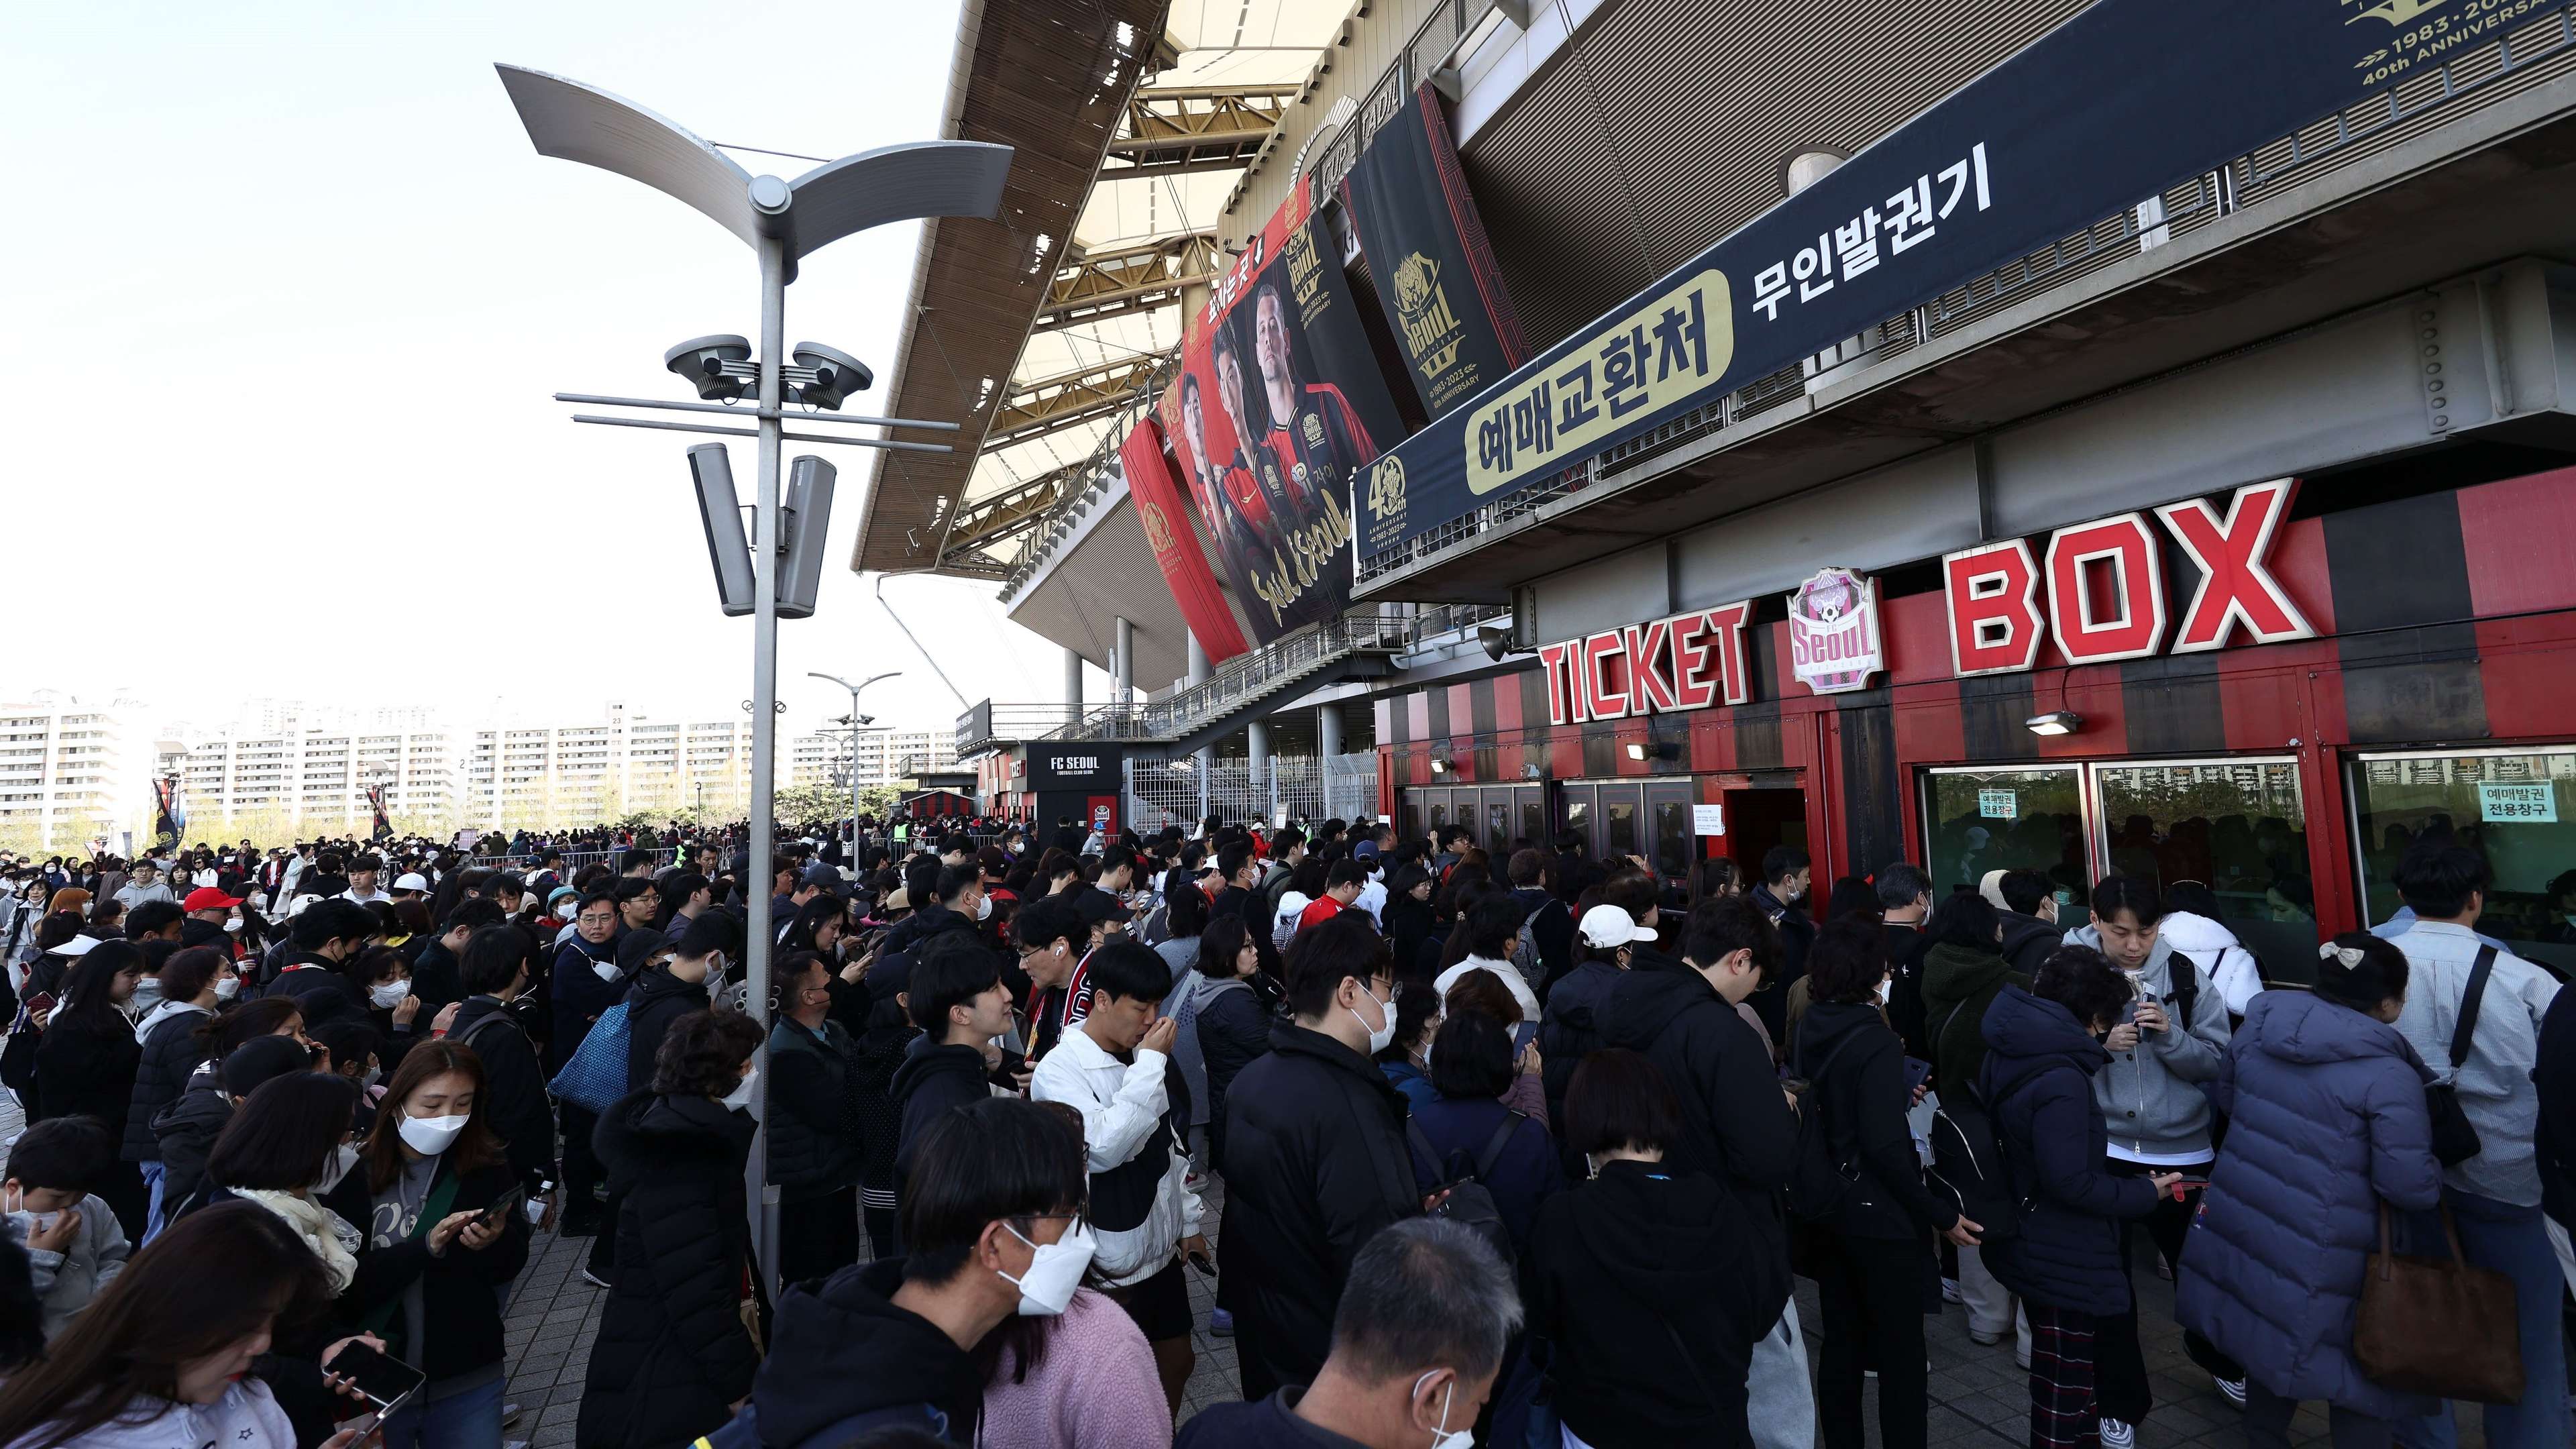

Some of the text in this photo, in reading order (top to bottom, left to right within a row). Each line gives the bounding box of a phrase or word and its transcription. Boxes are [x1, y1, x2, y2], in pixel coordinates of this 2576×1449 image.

[2362, 57, 2410, 86] 40th
[1398, 281, 1461, 360] Seoul
[1417, 308, 1424, 319] FC
[1479, 142, 1992, 474] 예매교환처 무인발권기
[1440, 373, 1480, 404] ANNIVERSARY
[1369, 512, 1407, 535] ANNIVERSARY
[1536, 477, 2317, 727] TICKET BOX
[1792, 607, 1875, 666] Seoul
[1051, 756, 1100, 770] FC SEOUL
[2487, 788, 2544, 801] 예매발권
[2489, 804, 2547, 816] 전용창구
